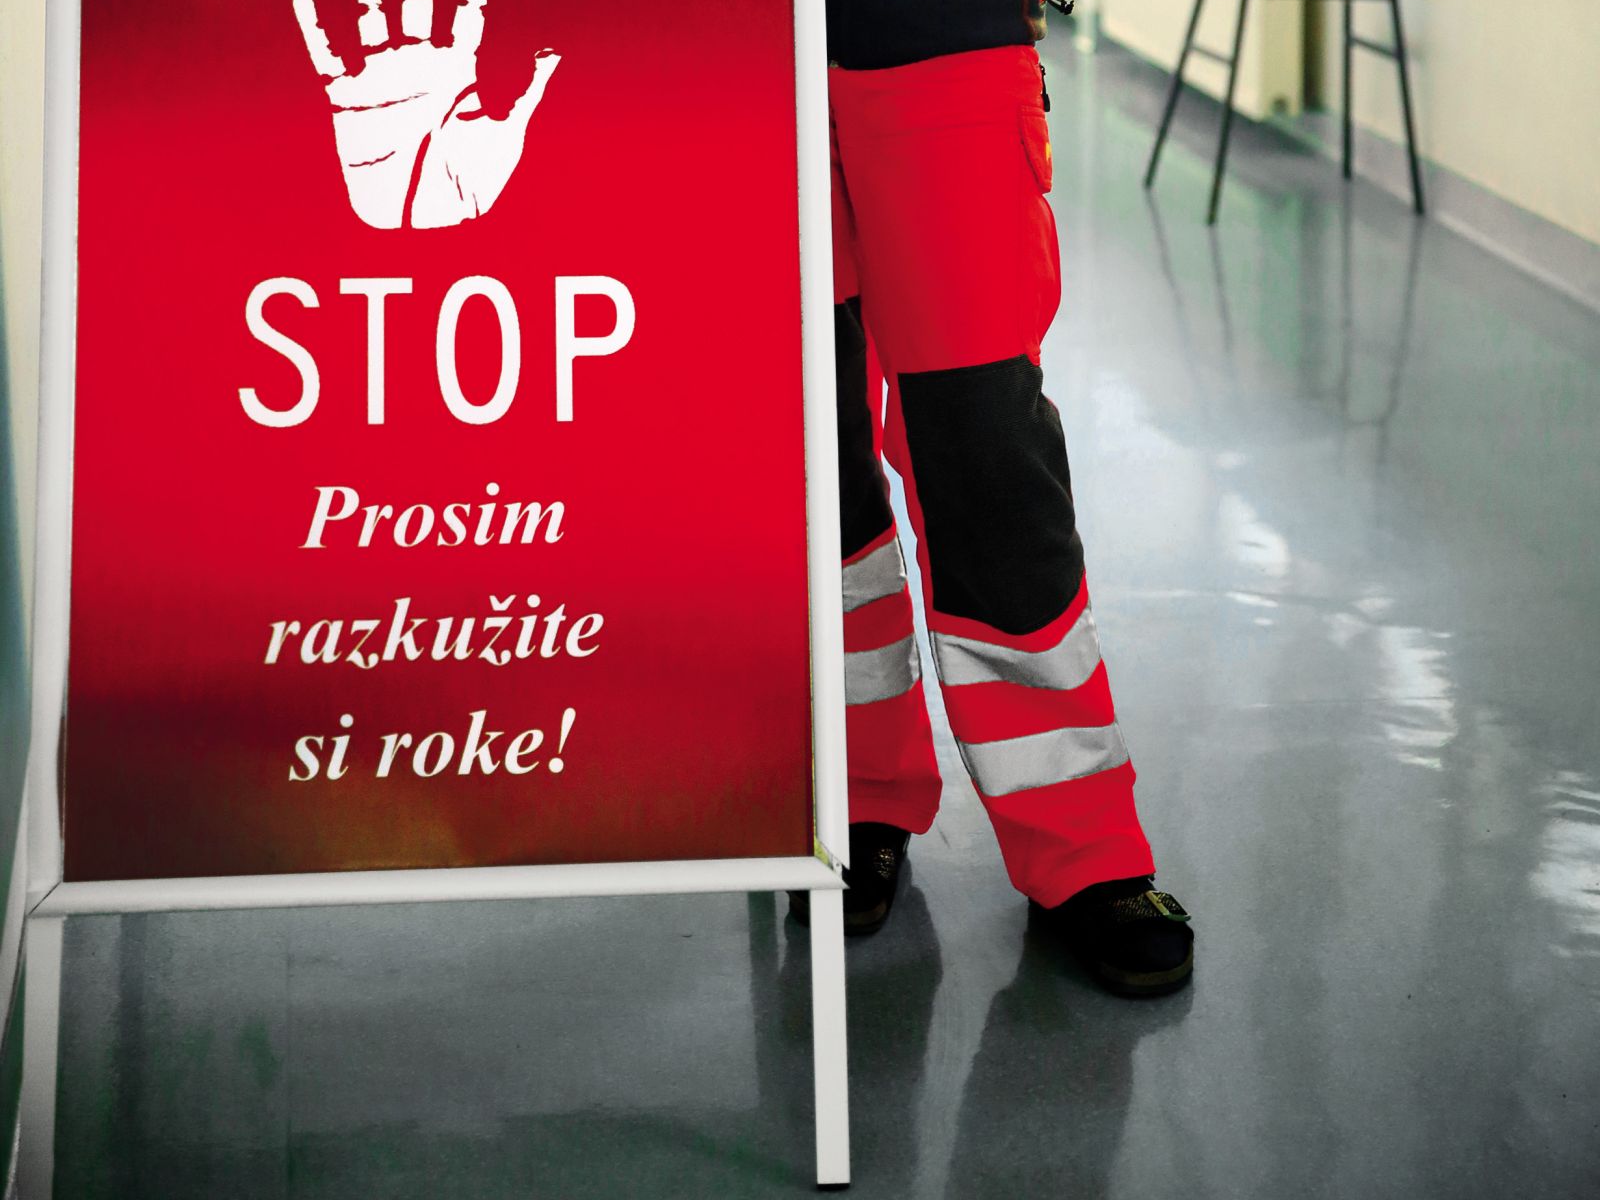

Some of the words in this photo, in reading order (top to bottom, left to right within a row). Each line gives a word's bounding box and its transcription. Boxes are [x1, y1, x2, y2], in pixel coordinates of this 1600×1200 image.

[238, 275, 636, 428] STOP
[300, 482, 566, 550] Prosim
[264, 594, 605, 670] razkužite
[288, 713, 355, 782] si
[376, 707, 578, 779] roke!
